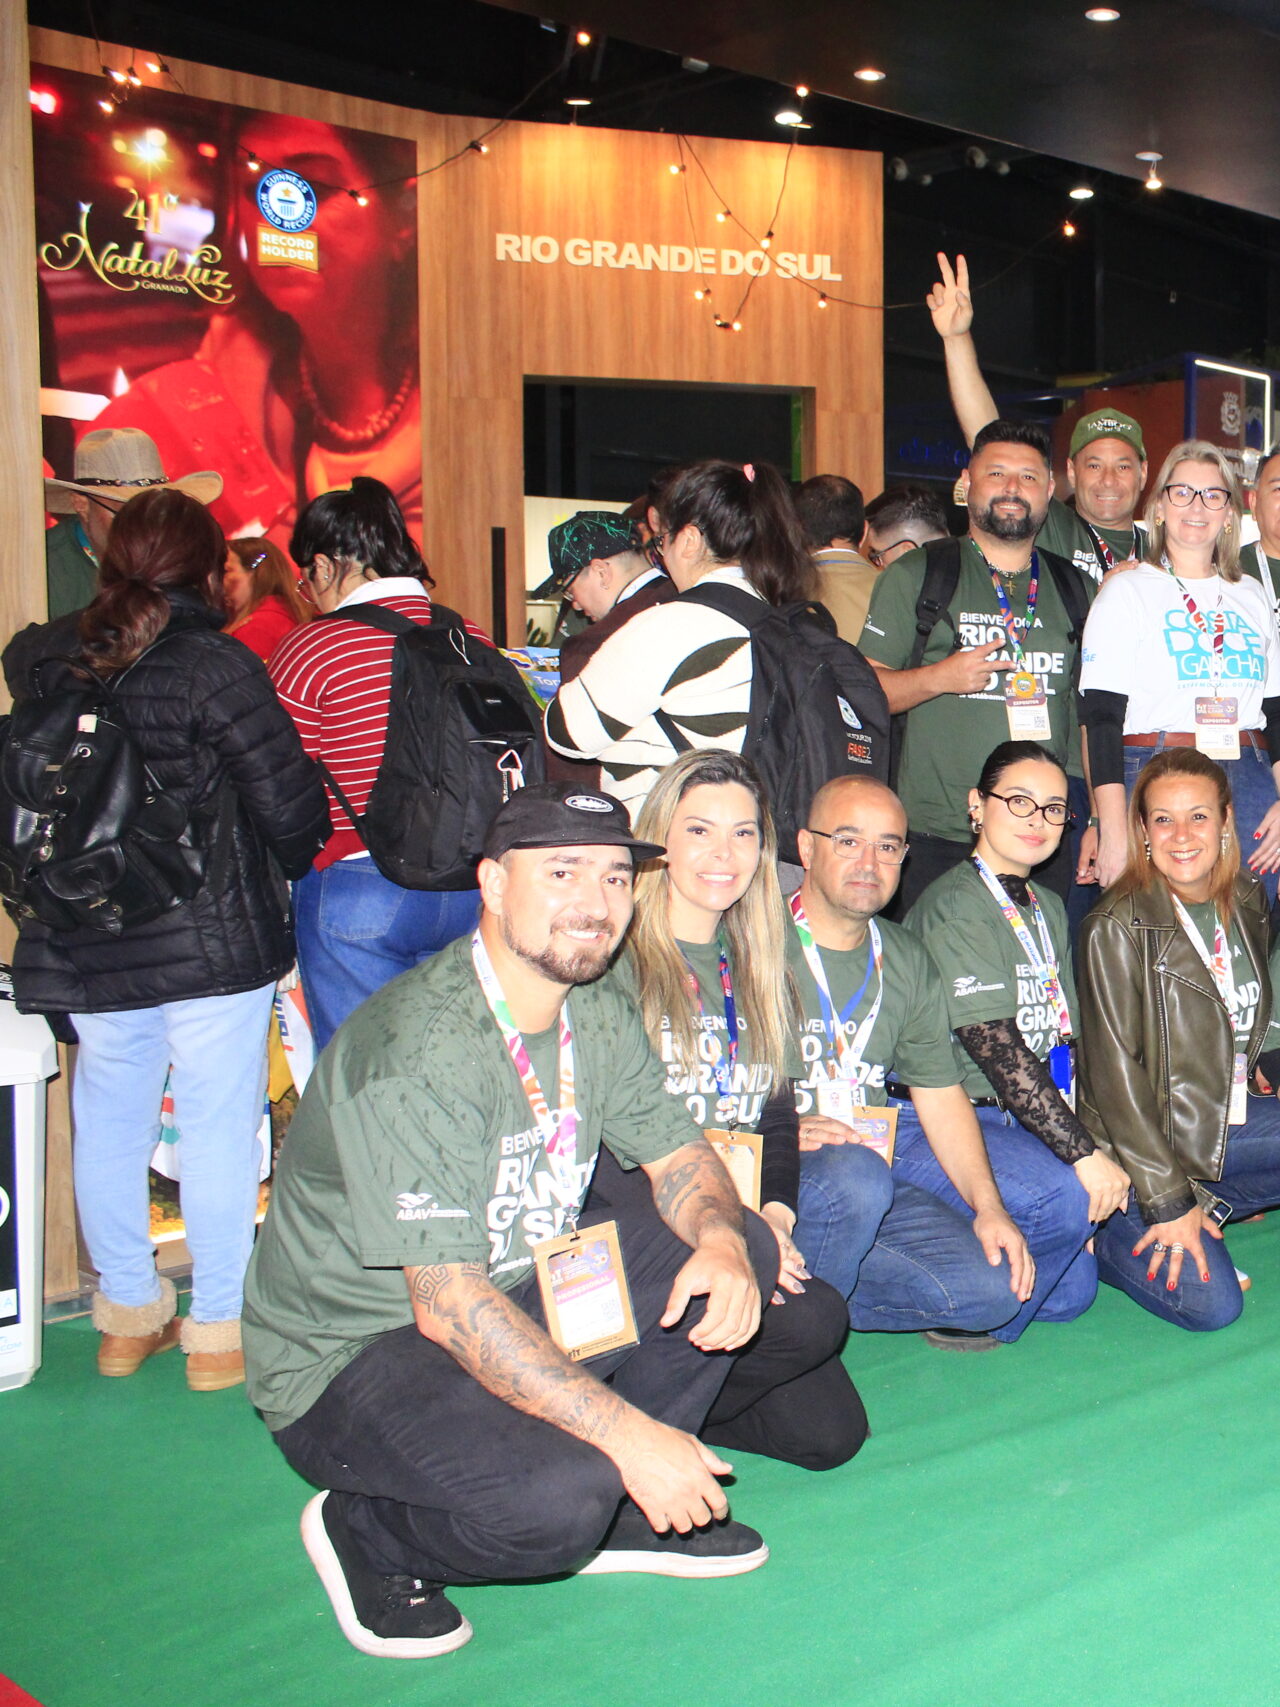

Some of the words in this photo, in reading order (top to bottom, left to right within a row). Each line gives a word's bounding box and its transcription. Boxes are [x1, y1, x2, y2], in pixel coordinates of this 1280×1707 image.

[264, 173, 309, 194] GUINNESS
[261, 192, 283, 225] WORLD
[284, 201, 315, 230] RECORDS
[262, 232, 315, 250] RECORD
[262, 245, 314, 261] HOLDER
[495, 233, 559, 264] RIO
[564, 238, 717, 274] GRANDE
[721, 249, 770, 277] DO
[775, 252, 843, 281] SUL
[955, 986, 978, 997] ABAV
[397, 1209, 431, 1220] ABAV
